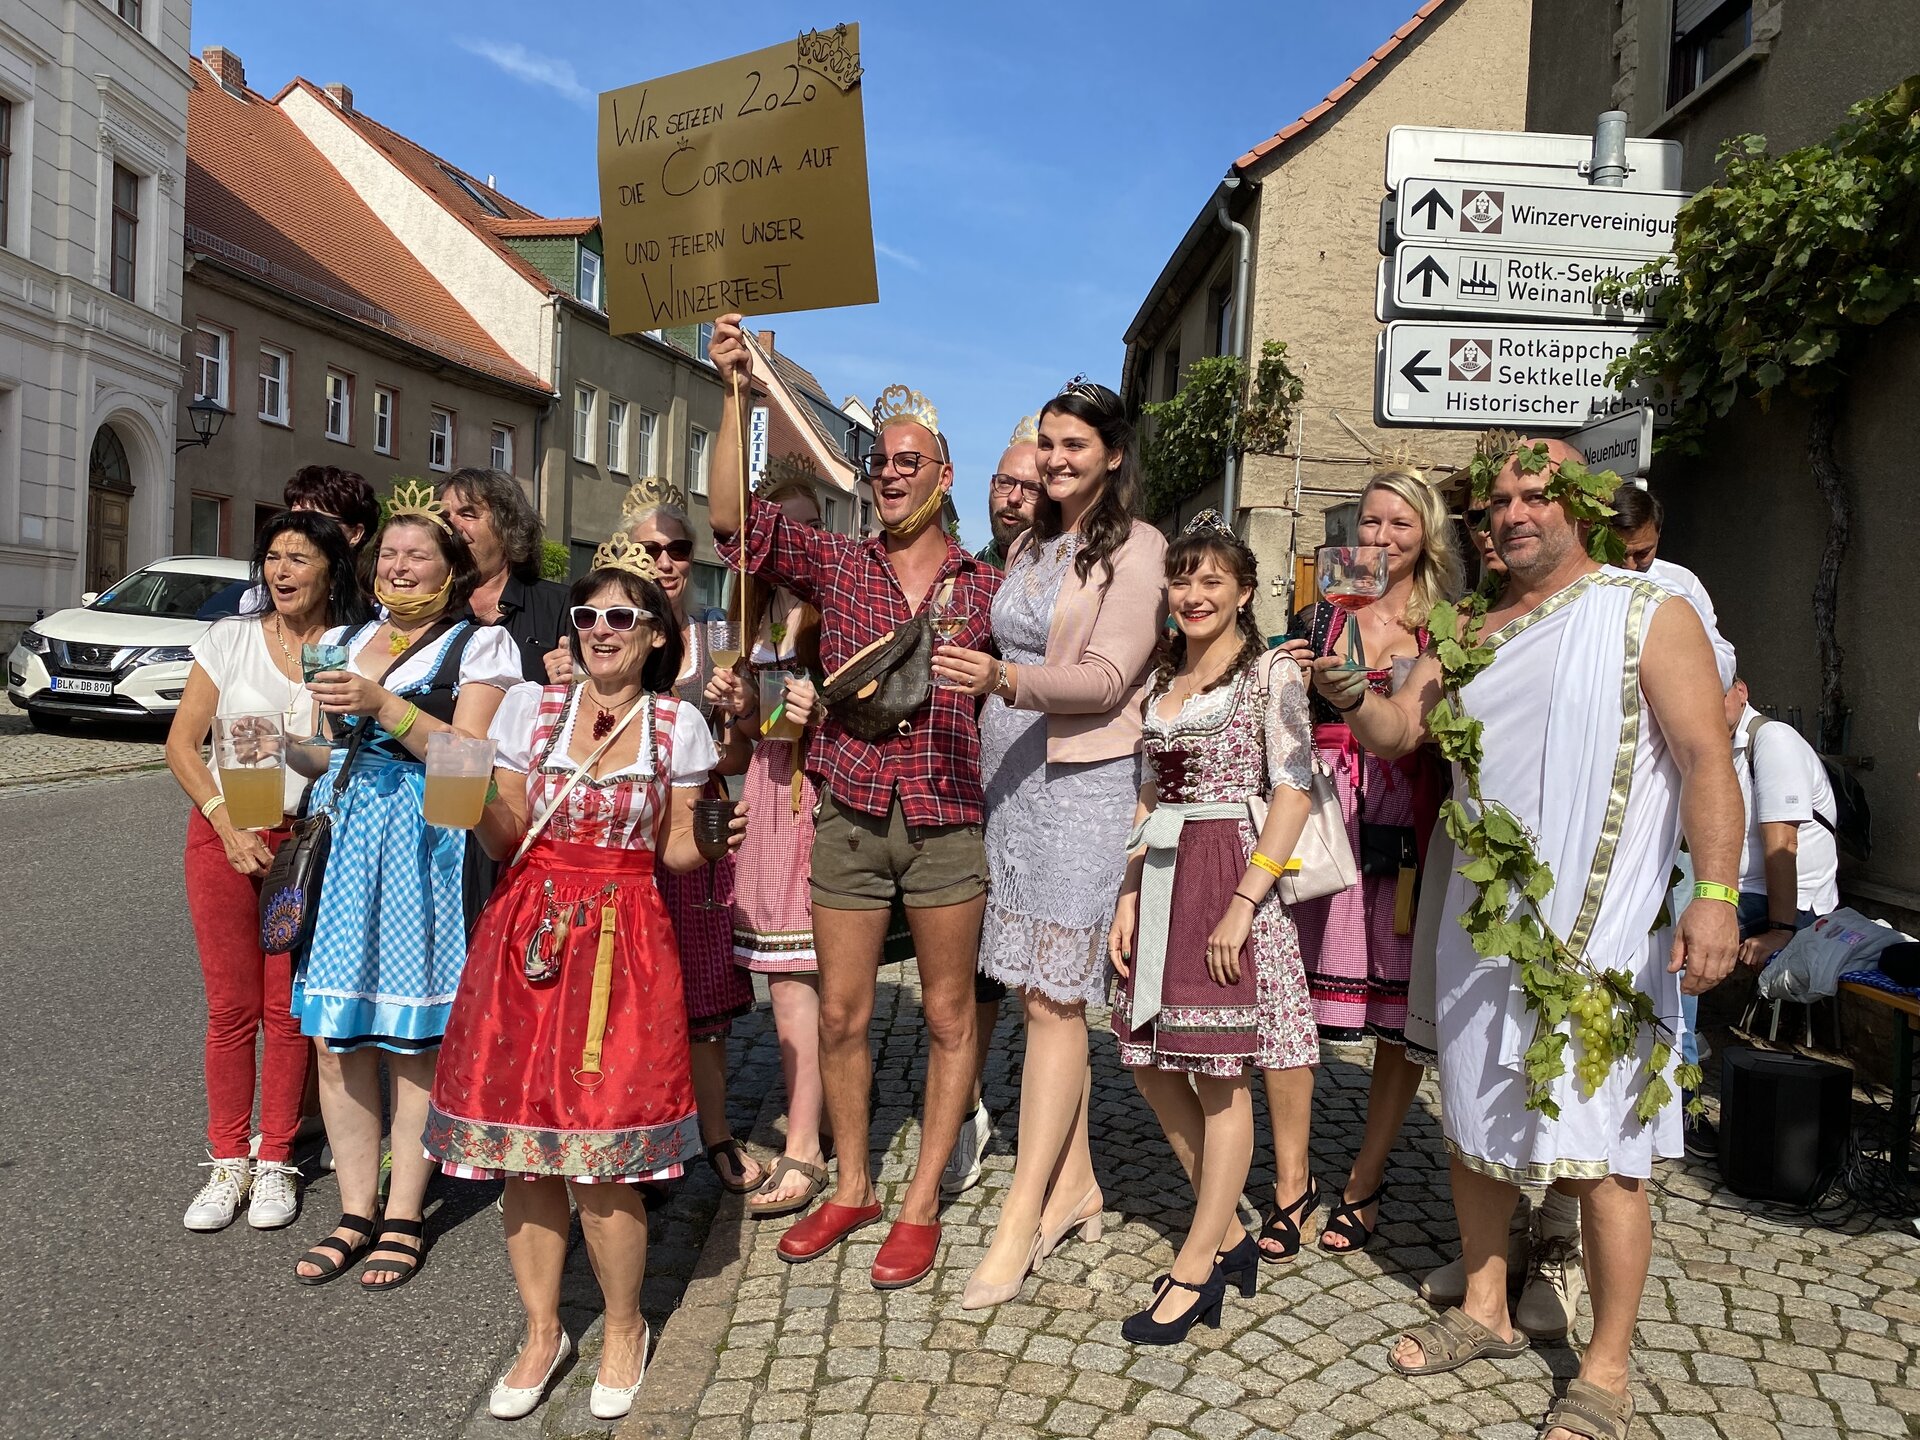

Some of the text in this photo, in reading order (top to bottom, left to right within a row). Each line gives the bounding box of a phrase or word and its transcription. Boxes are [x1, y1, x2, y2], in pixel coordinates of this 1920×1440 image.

[613, 64, 816, 147] WIR SETZEN 2020
[618, 146, 840, 207] DIE CORONA AUF
[1511, 204, 1678, 238] Winzervereinigu
[625, 217, 805, 266] UND FEIERN UNSER
[641, 263, 792, 324] WINZERFEST
[1499, 338, 1632, 363] Rotkäppche
[1498, 365, 1632, 388] Sektkelle
[1446, 391, 1580, 414] Historischer
[752, 412, 765, 472] TEXTIL
[1584, 437, 1638, 465] Neuenburg
[58, 679, 110, 693] BLK DB 890
